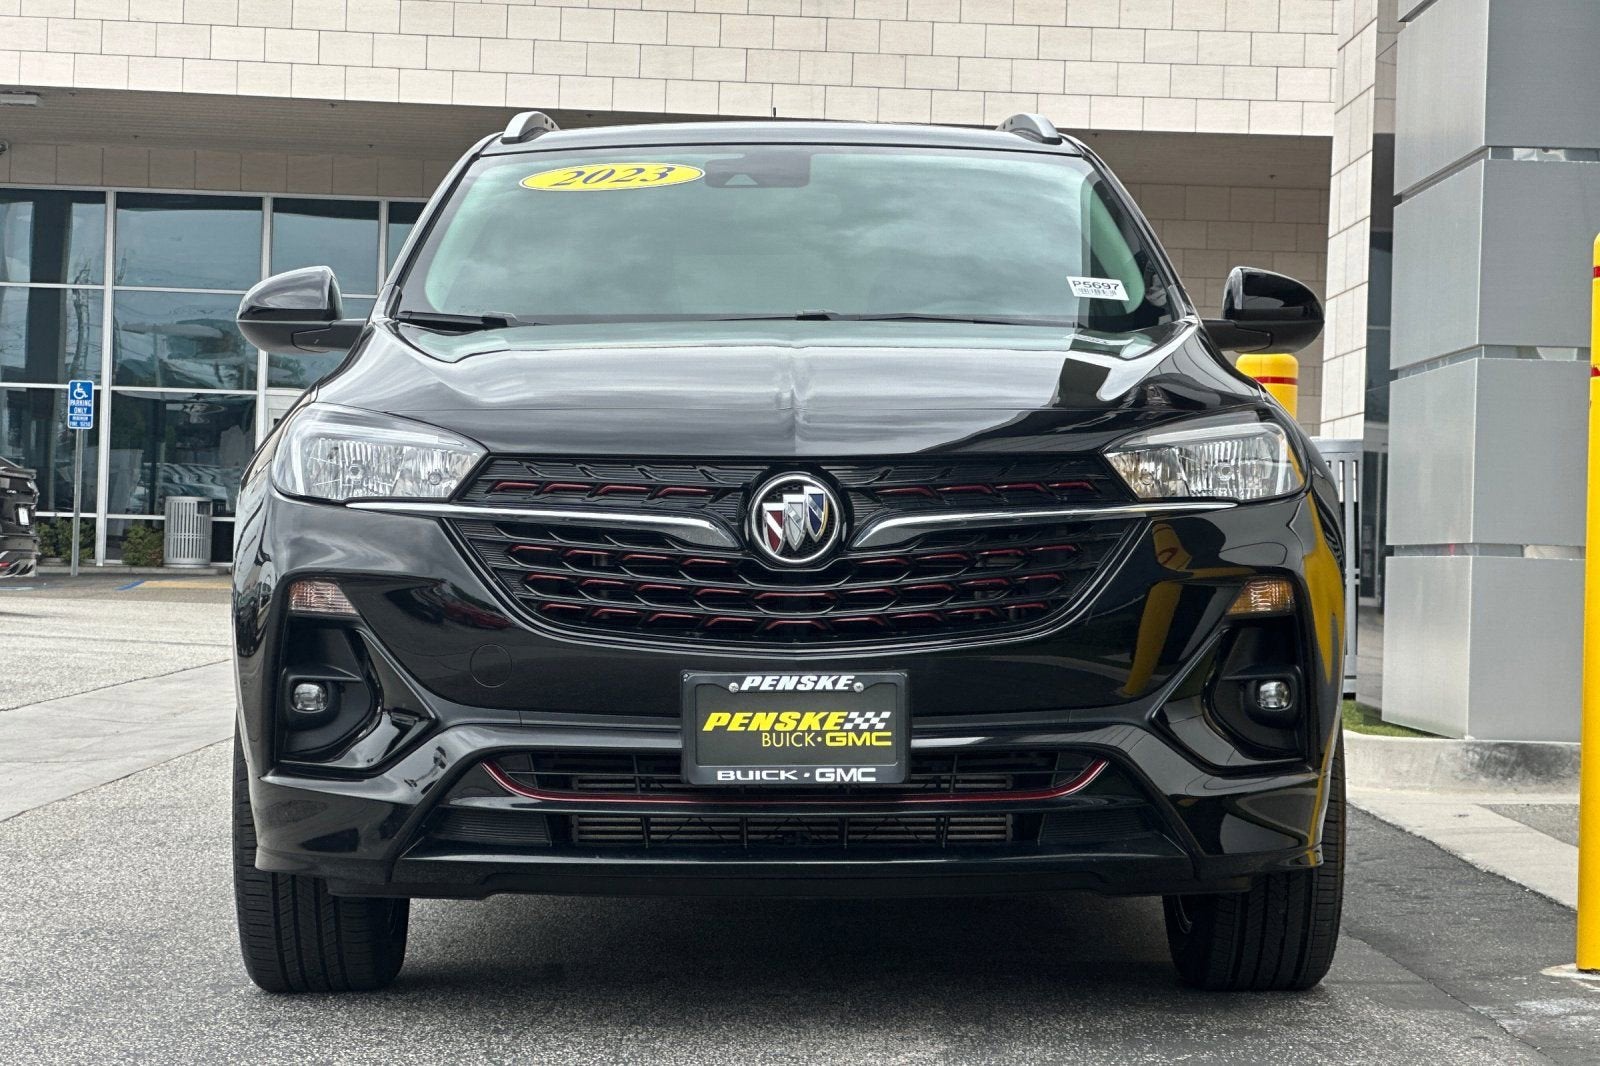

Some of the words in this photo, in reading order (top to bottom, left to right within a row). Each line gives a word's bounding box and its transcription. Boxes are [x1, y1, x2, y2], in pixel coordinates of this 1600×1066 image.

[548, 166, 676, 187] 2023
[1072, 280, 1119, 290] P5697
[69, 399, 92, 407] PARKING
[739, 675, 855, 691] PENSKE
[702, 711, 848, 731] PENSKE
[761, 732, 816, 747] BUICK
[825, 731, 893, 747] GMC
[717, 769, 799, 781] BUICK
[815, 767, 877, 782] GMC
